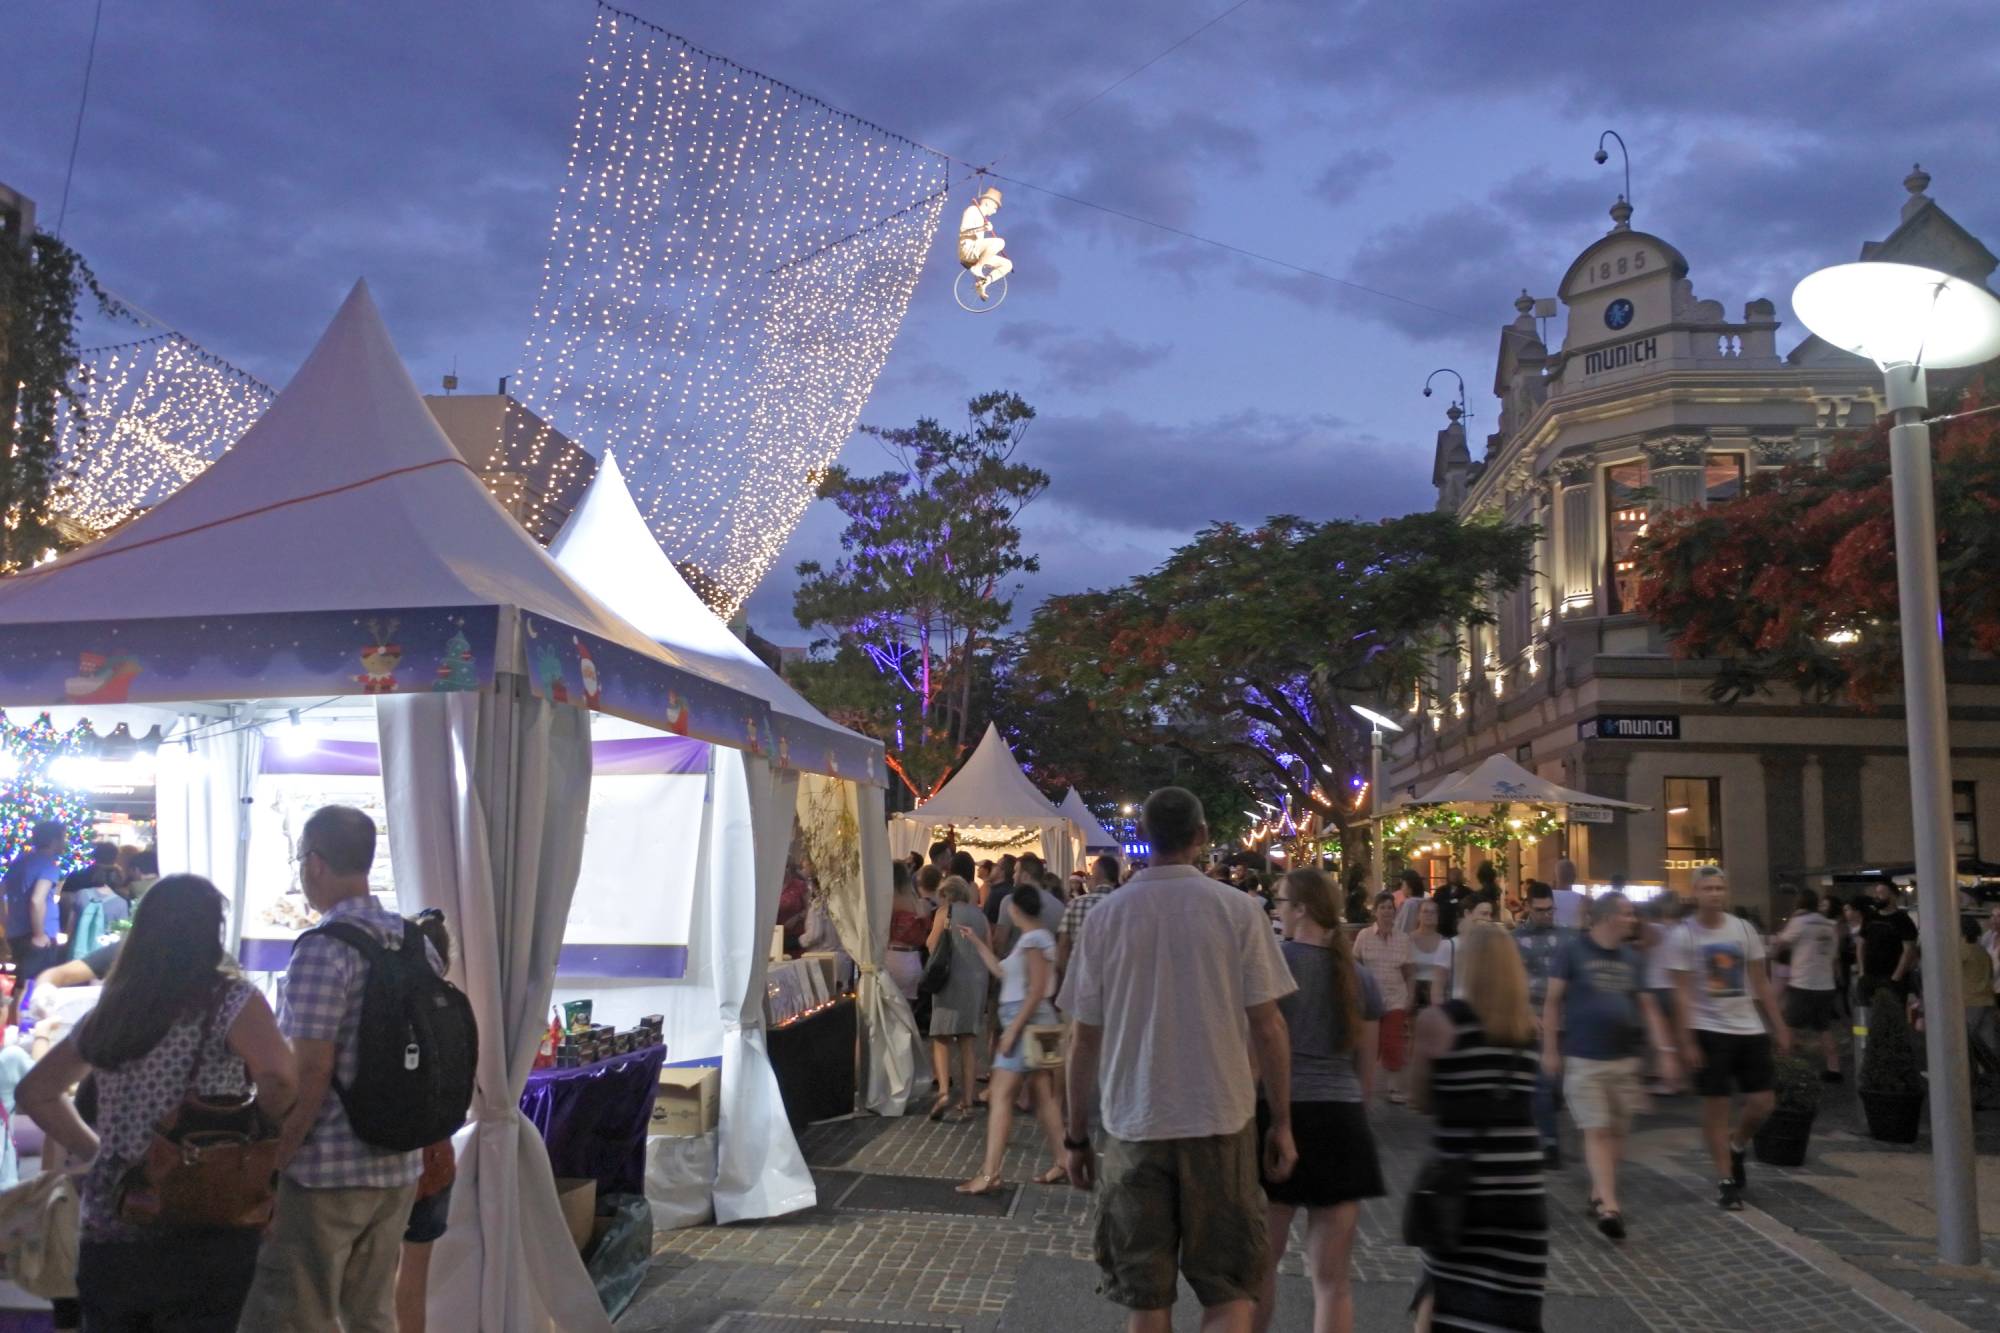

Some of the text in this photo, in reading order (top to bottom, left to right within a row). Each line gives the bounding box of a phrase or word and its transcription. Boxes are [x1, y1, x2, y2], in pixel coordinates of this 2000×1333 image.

[1589, 250, 1646, 283] 1885
[1585, 338, 1657, 375] MUNICH
[1619, 719, 1673, 735] MUNICH
